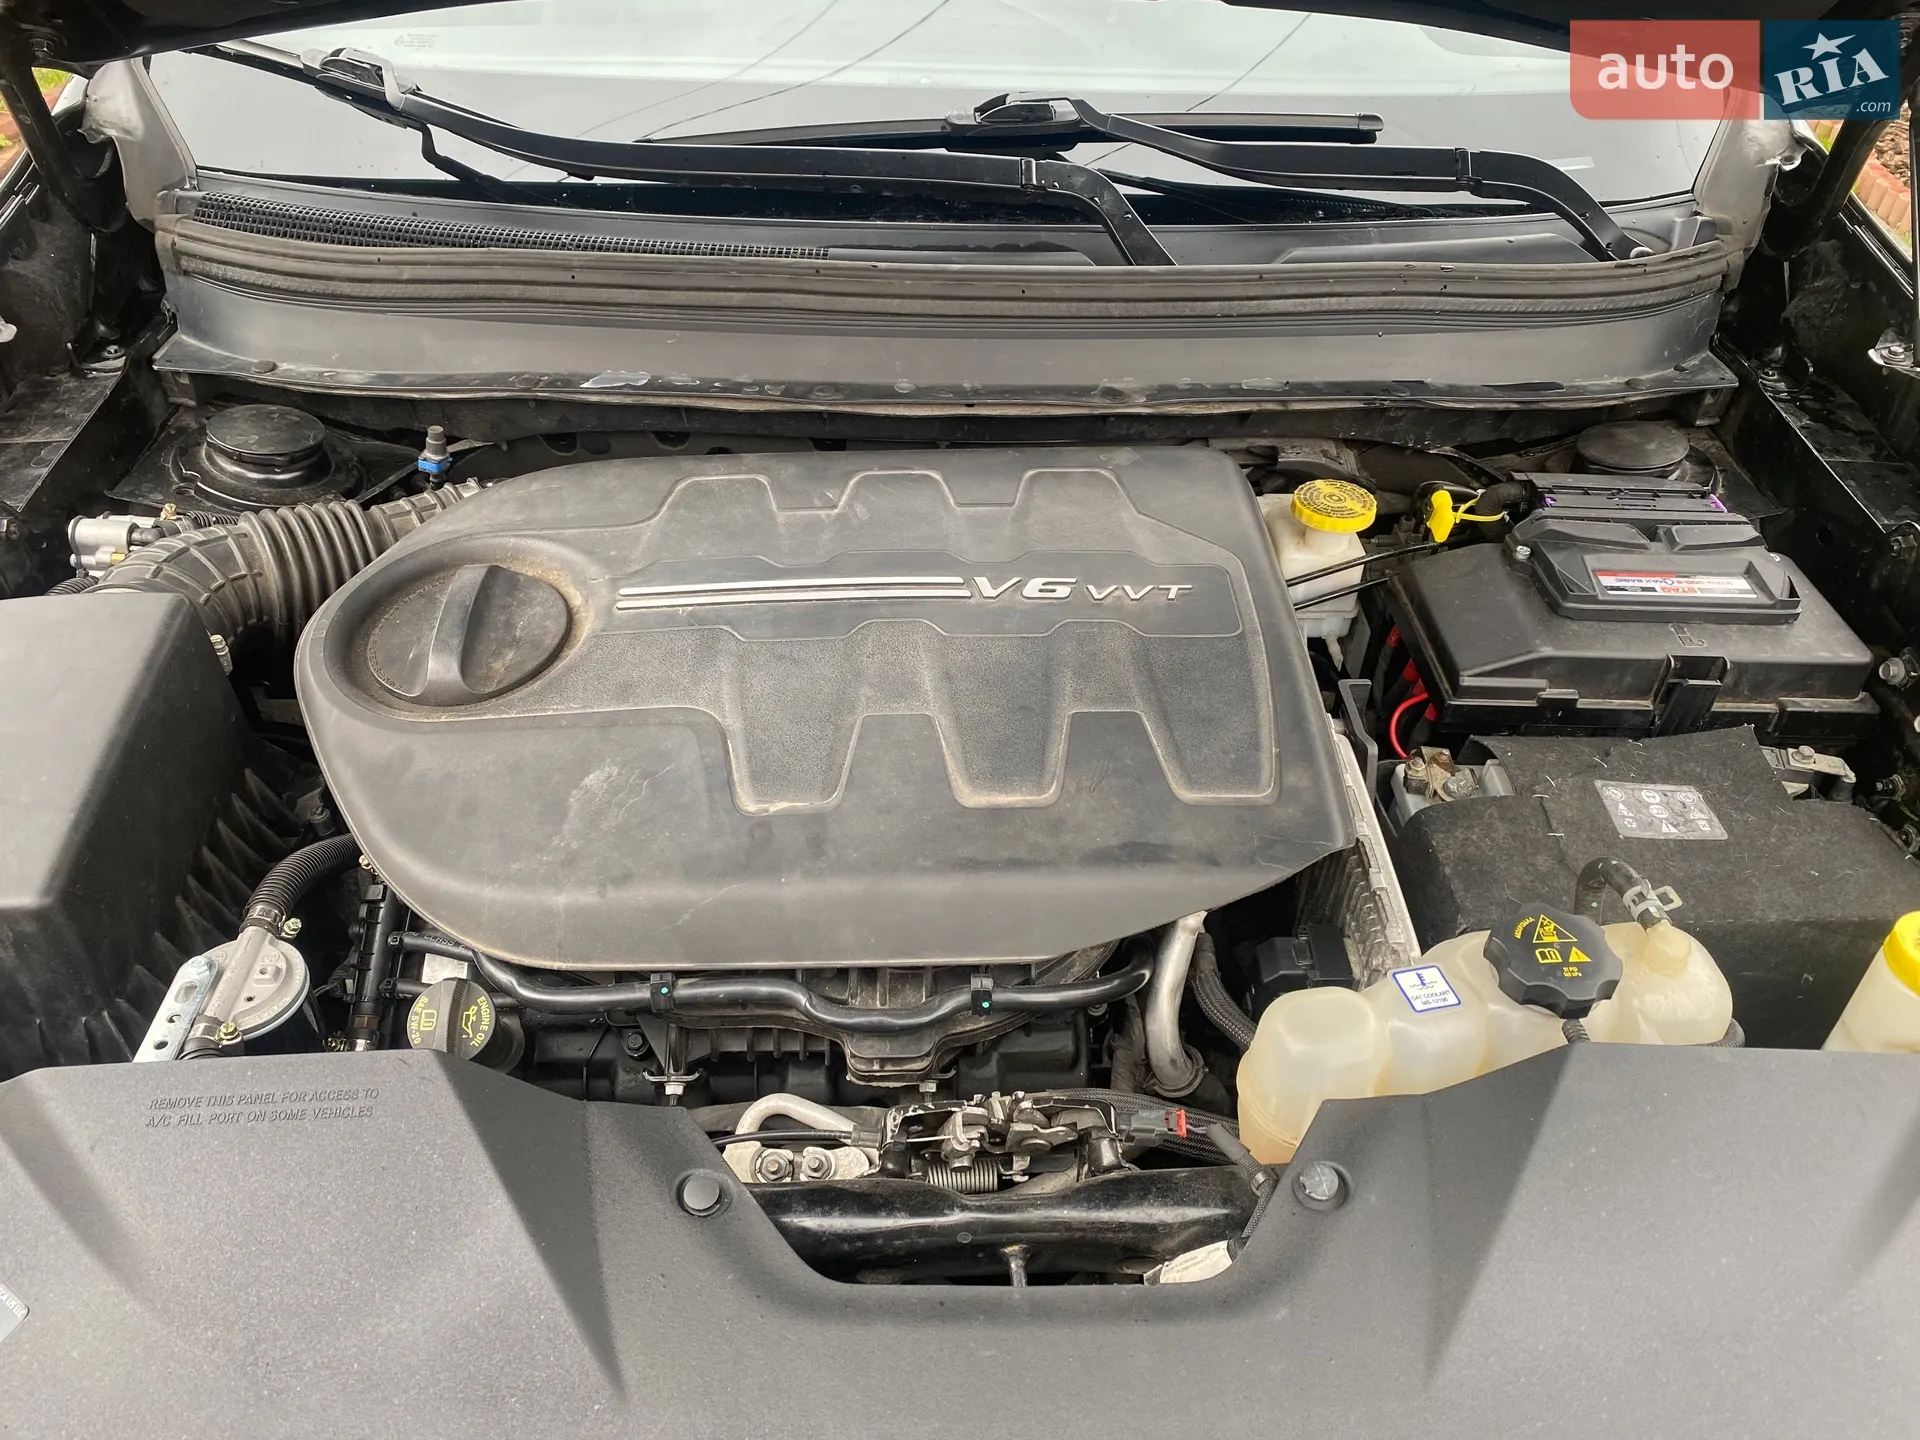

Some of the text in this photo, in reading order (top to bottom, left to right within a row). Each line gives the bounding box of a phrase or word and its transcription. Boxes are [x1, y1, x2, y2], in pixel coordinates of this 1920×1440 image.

[970, 577, 1193, 601] V6 VVT
[1659, 586, 1698, 594] STAG
[1423, 989, 1451, 999] COOLANT
[410, 995, 429, 1045] SAE 5W-20
[470, 995, 491, 1047] ENGINE OIL
[149, 1088, 380, 1110] REMOVE THIS PANEL FOR ACCESS TO
[145, 1105, 374, 1128] A/C FILL PORT ON SOME VEHICLES
